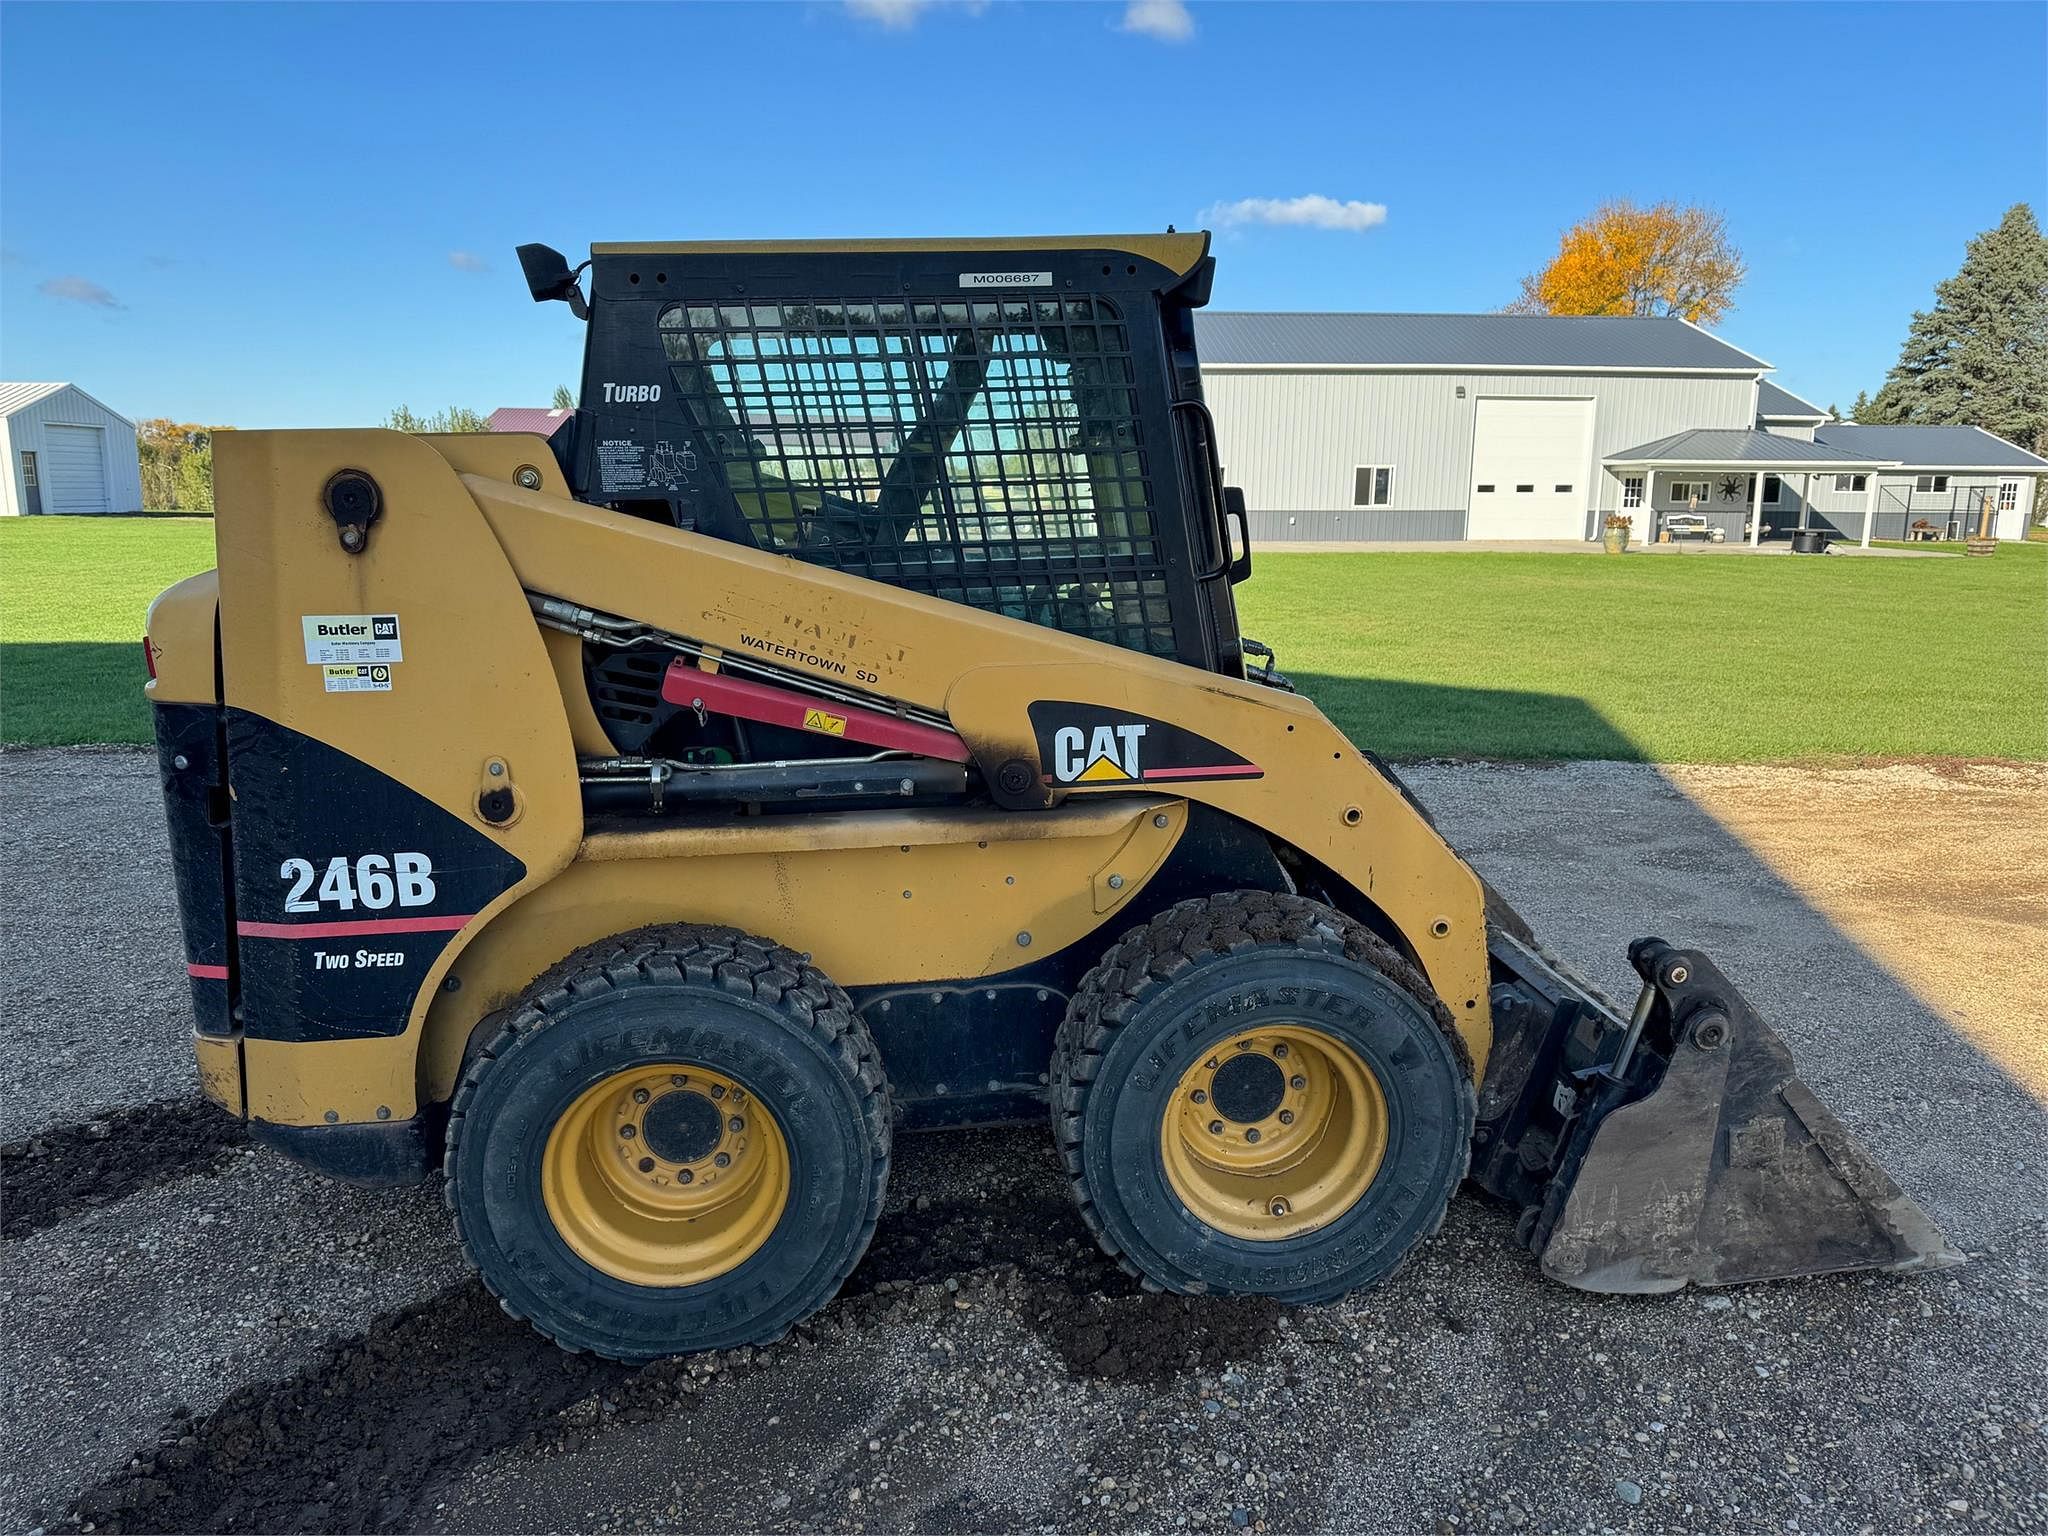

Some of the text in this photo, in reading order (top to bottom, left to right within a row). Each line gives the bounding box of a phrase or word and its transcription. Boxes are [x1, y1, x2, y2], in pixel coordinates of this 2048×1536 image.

[973, 274, 1039, 284] M006687
[603, 382, 661, 403] TURBO
[318, 623, 395, 635] Butler CAT
[740, 633, 846, 675] WATERTOWN
[855, 669, 878, 684] SD
[1054, 723, 1147, 783] CAT
[280, 852, 437, 913] 246B
[355, 950, 404, 968] SPEED
[1134, 984, 1378, 1092] LIFEMASTER
[1371, 985, 1440, 1063] SOLIDEAL
